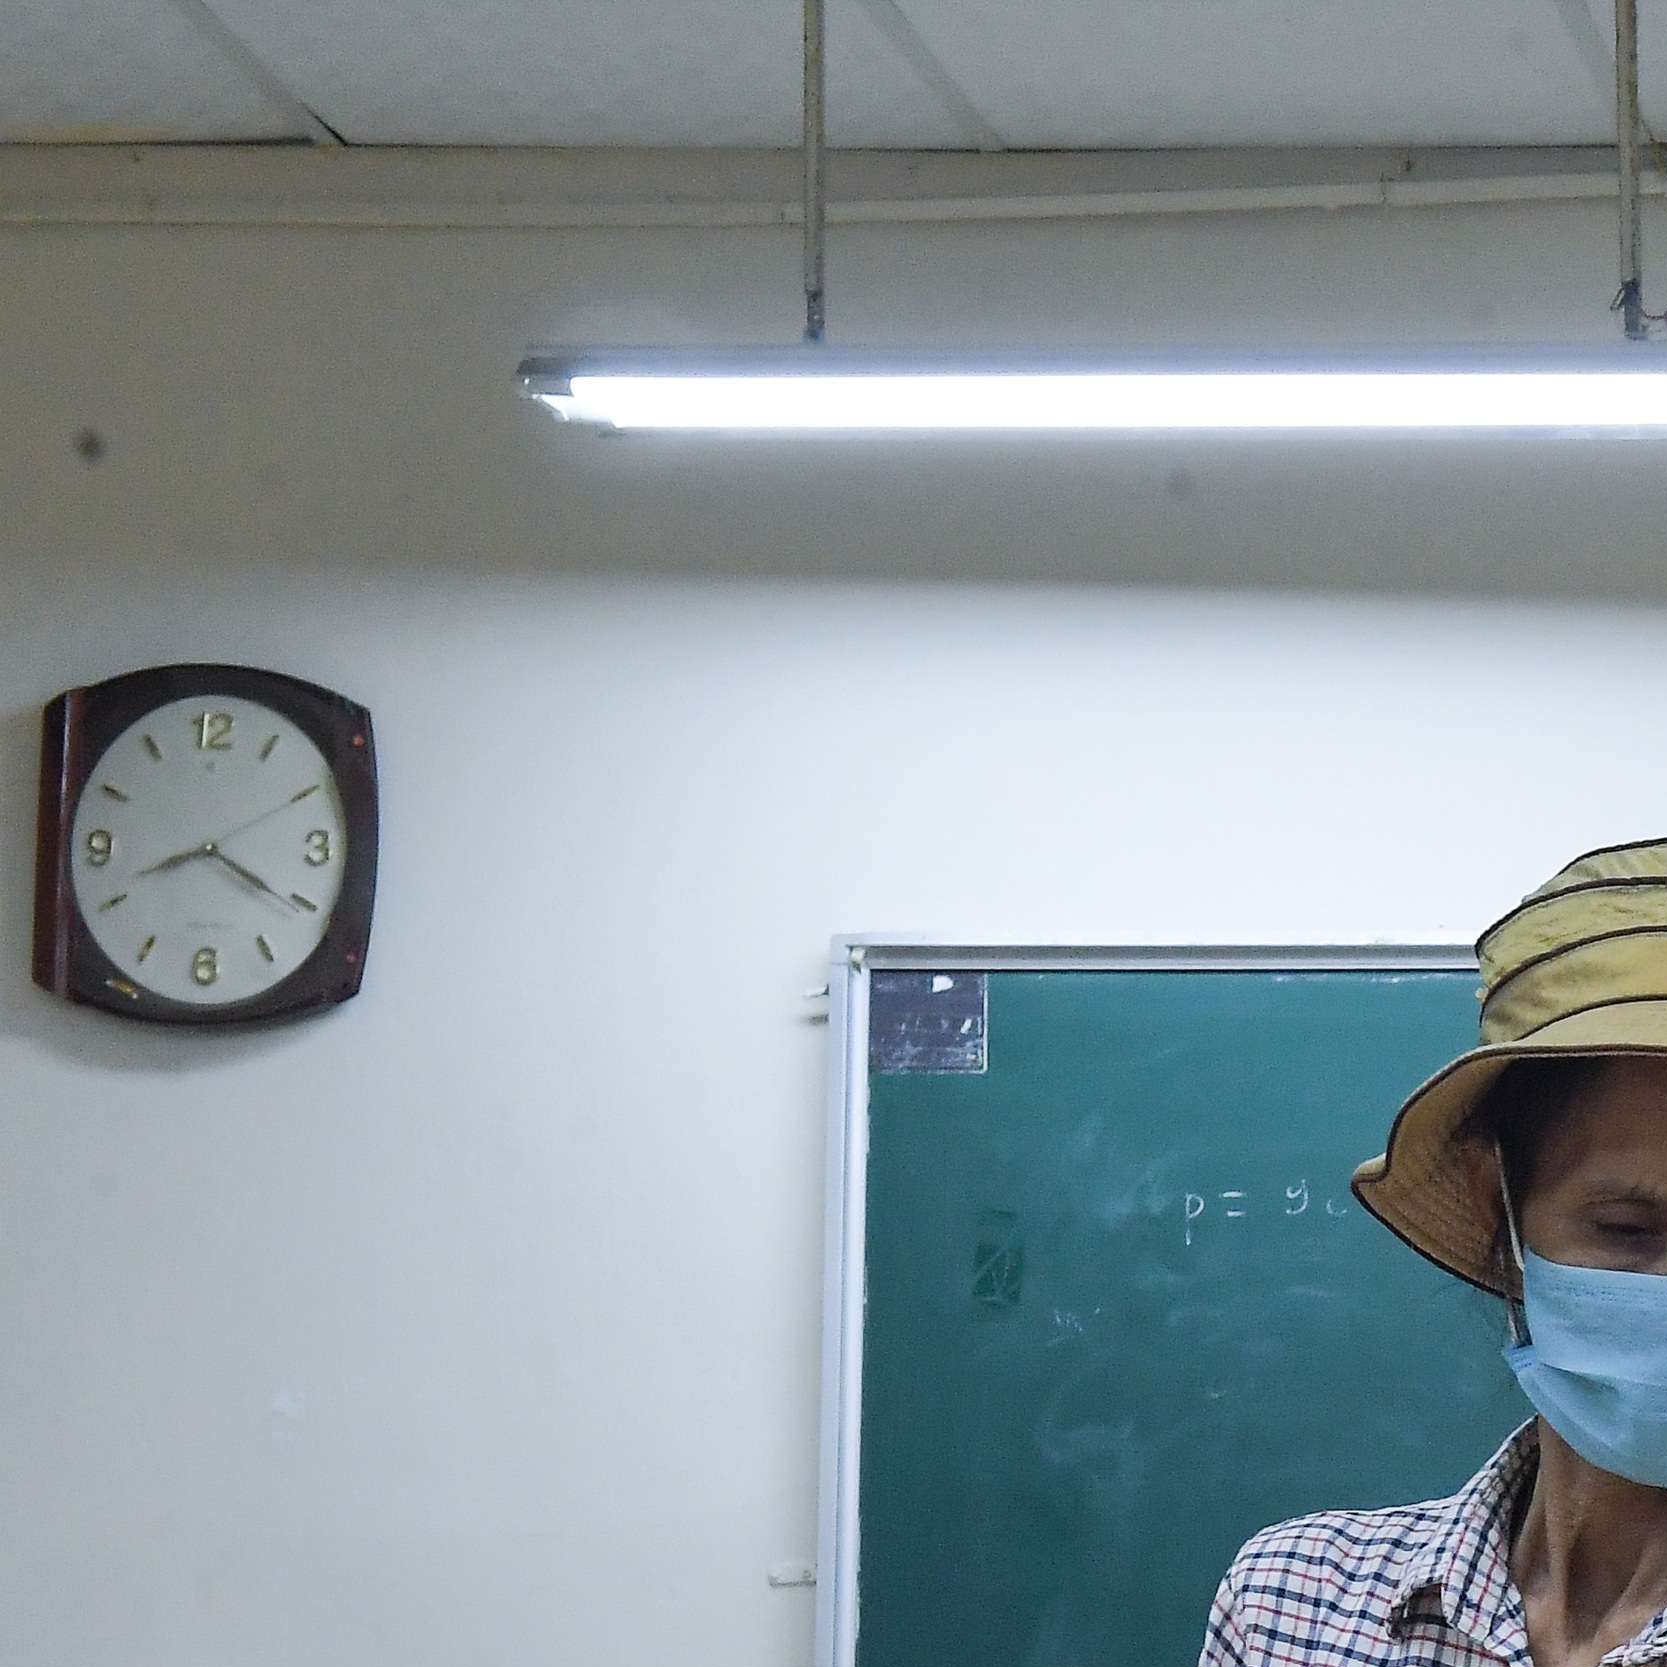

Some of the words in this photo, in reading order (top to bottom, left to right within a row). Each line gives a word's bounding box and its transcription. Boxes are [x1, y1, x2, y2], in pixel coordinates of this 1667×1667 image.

[193, 712, 233, 750] 12
[87, 829, 113, 867] 9
[303, 829, 330, 867] 3
[192, 947, 219, 986] 6
